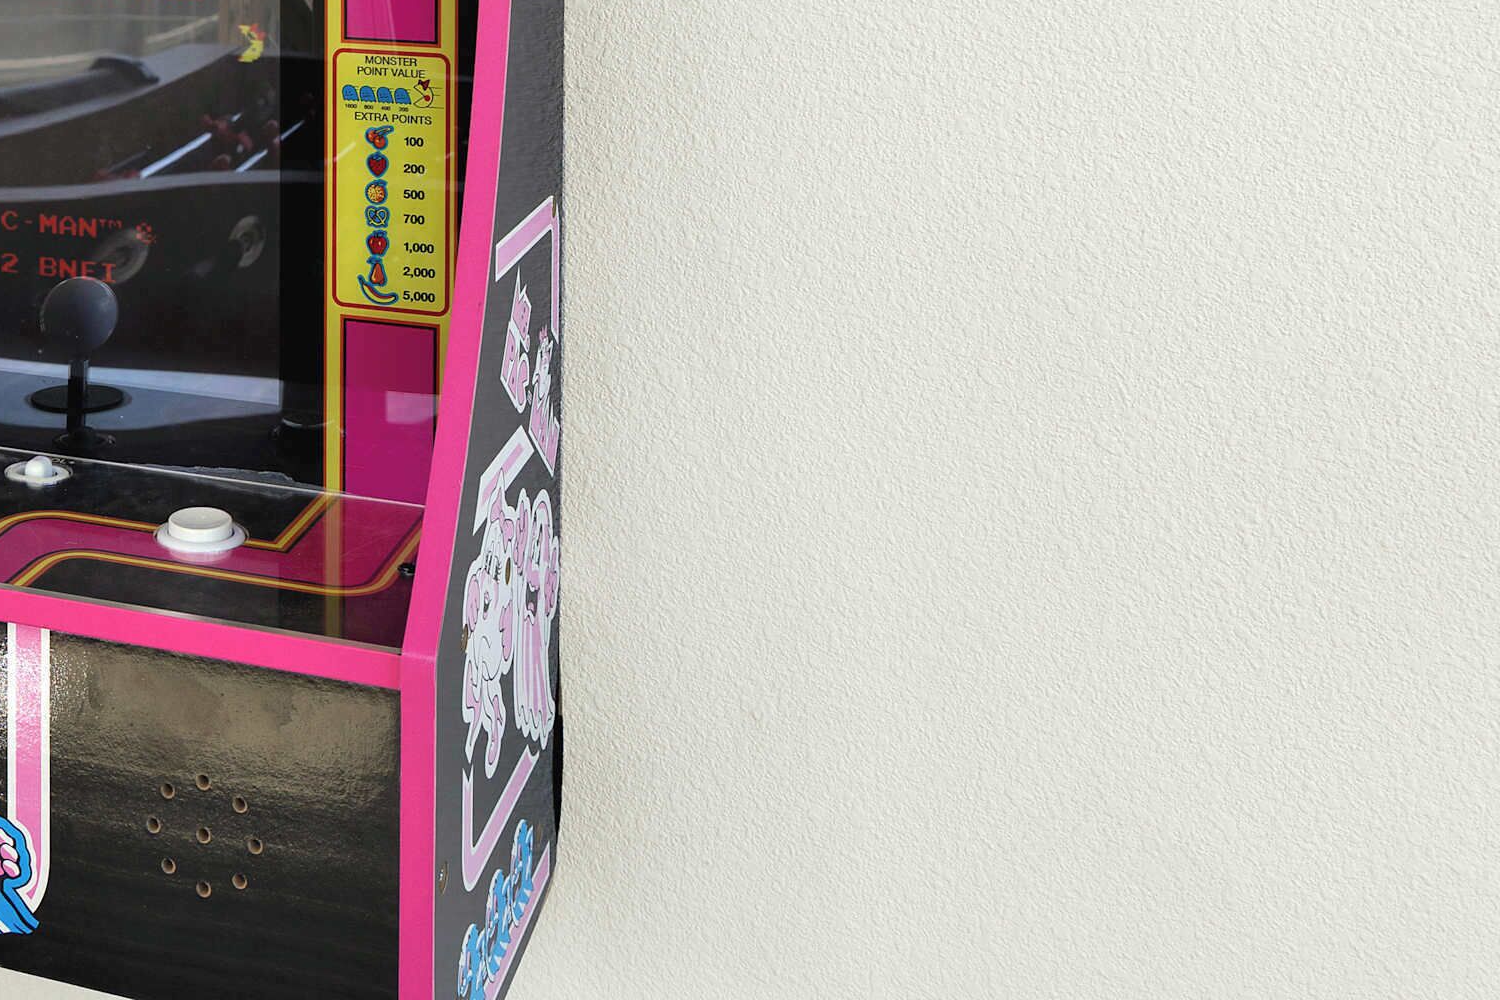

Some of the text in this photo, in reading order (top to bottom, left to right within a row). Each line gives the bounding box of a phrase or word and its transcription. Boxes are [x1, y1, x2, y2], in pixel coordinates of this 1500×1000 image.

[364, 55, 418, 67] MONSTER
[356, 66, 427, 79] POINT VALUE
[354, 111, 433, 126] EXTRA POINTS
[403, 136, 424, 148] 100
[403, 163, 425, 175] 200
[403, 189, 425, 200] 500
[403, 213, 425, 225] 700
[403, 242, 435, 254] 1,000
[403, 266, 436, 279] 2,000
[402, 290, 436, 303] 5,000
